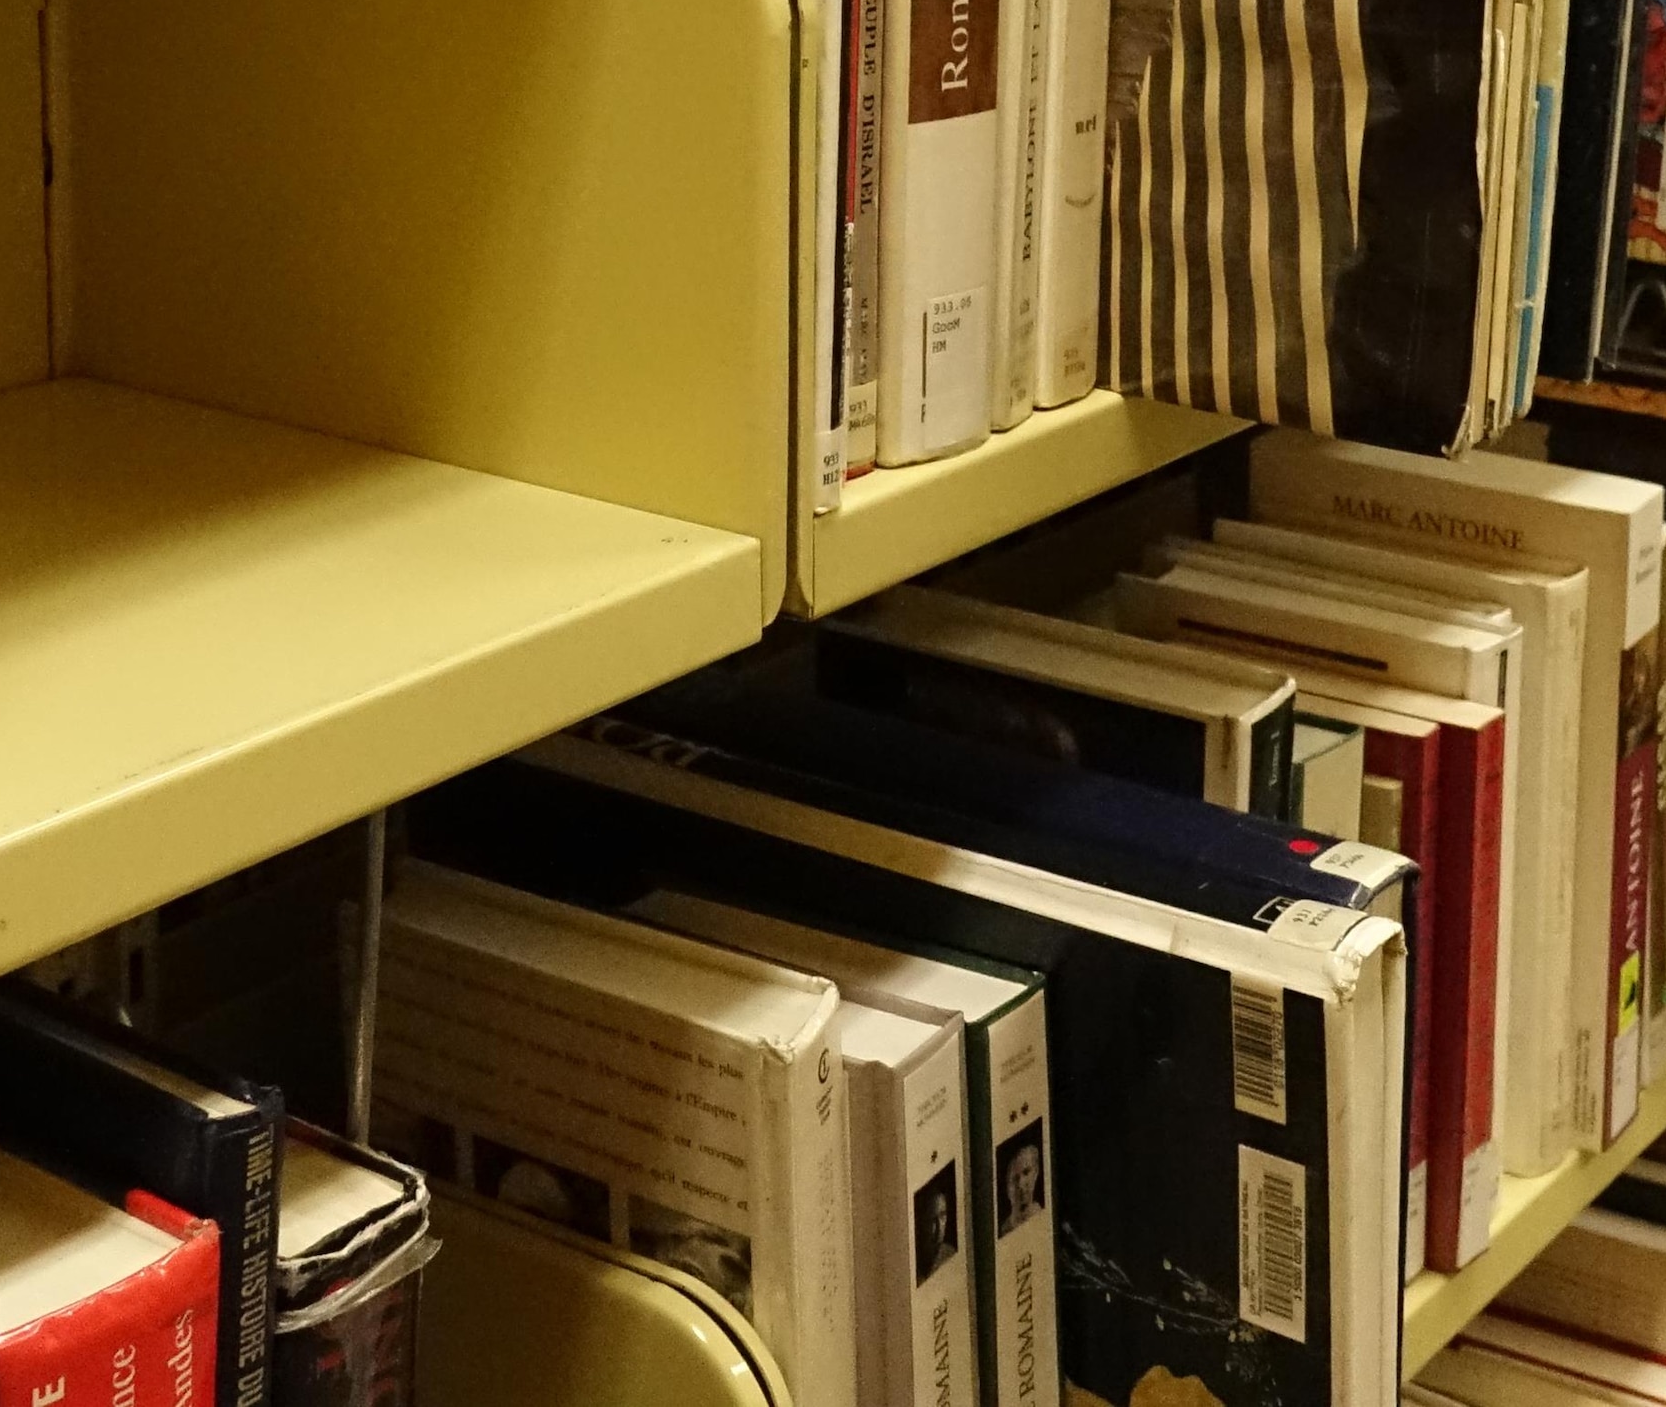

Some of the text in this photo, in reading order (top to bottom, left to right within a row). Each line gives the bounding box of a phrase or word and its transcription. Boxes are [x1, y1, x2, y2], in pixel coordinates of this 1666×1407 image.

[1332, 492, 1527, 552] MARC ANTOINE
[238, 1122, 275, 1407] TIME-LIFE HISTOIRE DU
[1015, 1251, 1037, 1402] ROMAINE
